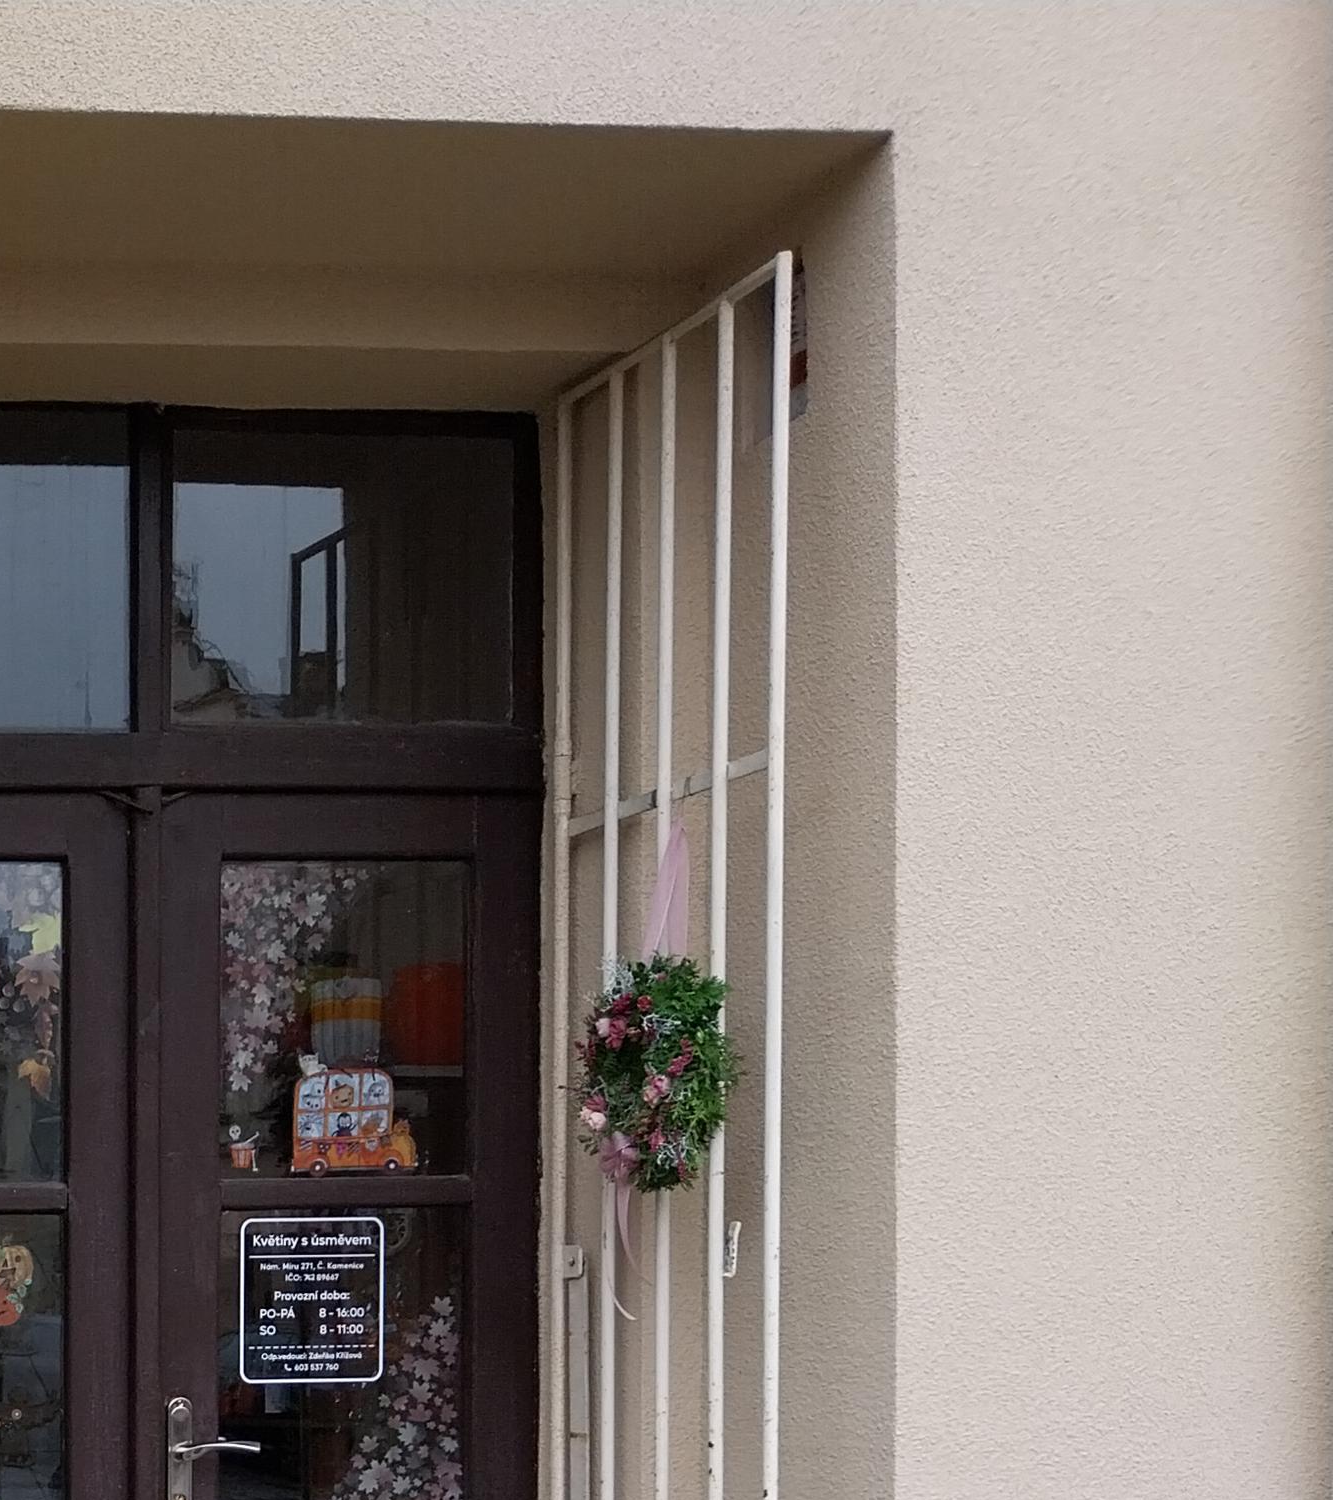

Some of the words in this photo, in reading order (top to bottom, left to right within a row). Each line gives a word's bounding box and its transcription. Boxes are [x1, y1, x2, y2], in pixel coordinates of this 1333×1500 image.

[252, 1234, 299, 1249] Květiny
[301, 1237, 309, 1246] s
[310, 1234, 372, 1246] úsměvem
[326, 1261, 365, 1270] Kamenice
[273, 1290, 319, 1301] Provozní
[320, 1290, 351, 1301] doba:
[259, 1305, 296, 1319] PO-PÁ
[318, 1308, 327, 1318] 8
[336, 1307, 365, 1318] 16:00
[259, 1325, 276, 1336] SO
[319, 1325, 327, 1335] 8
[336, 1324, 364, 1335] 11:00
